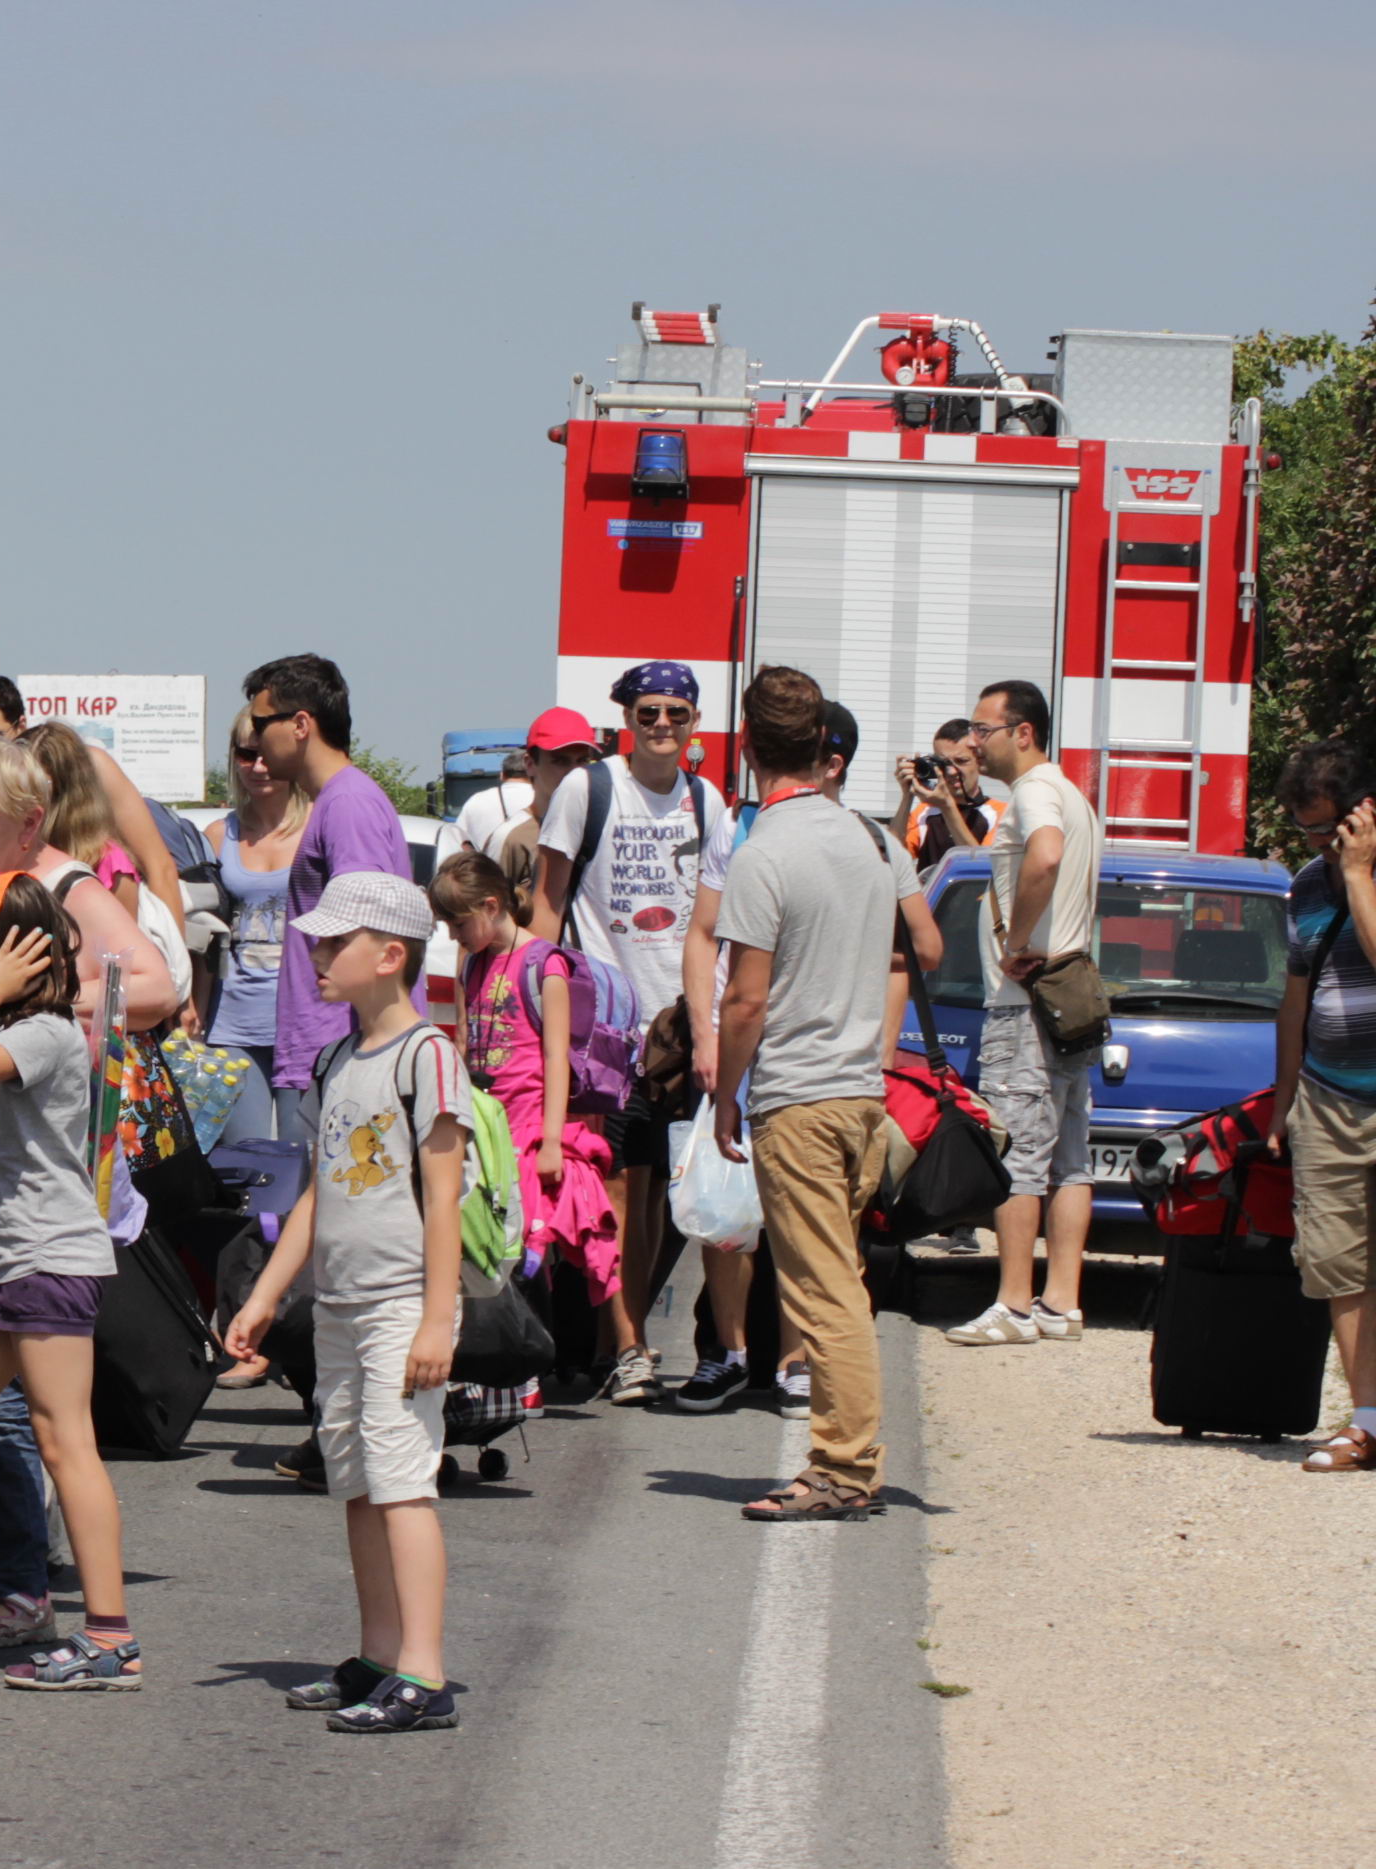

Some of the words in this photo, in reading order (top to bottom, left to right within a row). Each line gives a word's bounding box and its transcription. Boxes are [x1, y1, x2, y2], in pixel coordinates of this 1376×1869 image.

[26, 696, 68, 717] ТОП
[77, 696, 118, 717] КАР
[612, 842, 659, 862] YOUR
[611, 863, 666, 880] WORLD
[610, 881, 676, 896] WONDERS
[610, 898, 632, 913] ME
[899, 1032, 967, 1045] PEEOT
